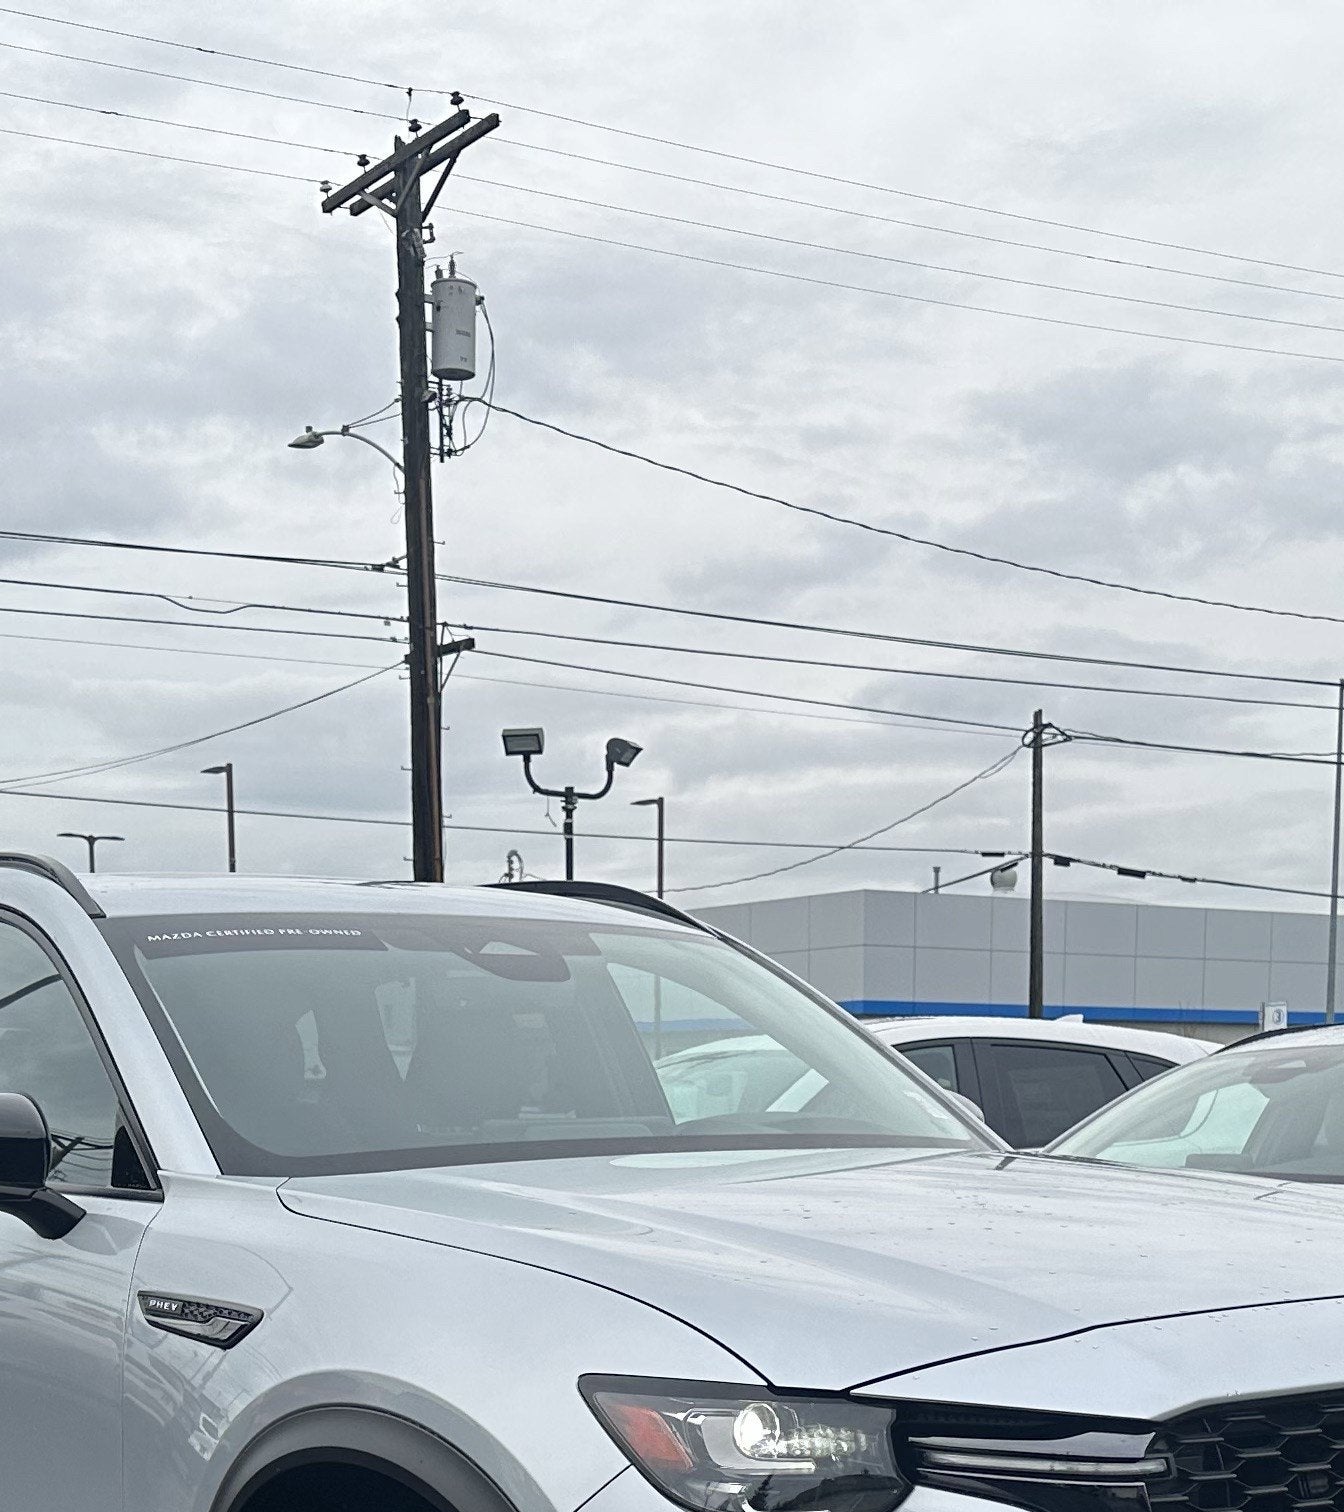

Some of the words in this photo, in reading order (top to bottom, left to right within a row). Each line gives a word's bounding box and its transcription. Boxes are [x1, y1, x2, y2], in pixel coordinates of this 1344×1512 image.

[147, 931, 203, 942] MAZDA
[205, 929, 275, 937] CERTIFIED
[149, 1299, 178, 1311] PHEV
